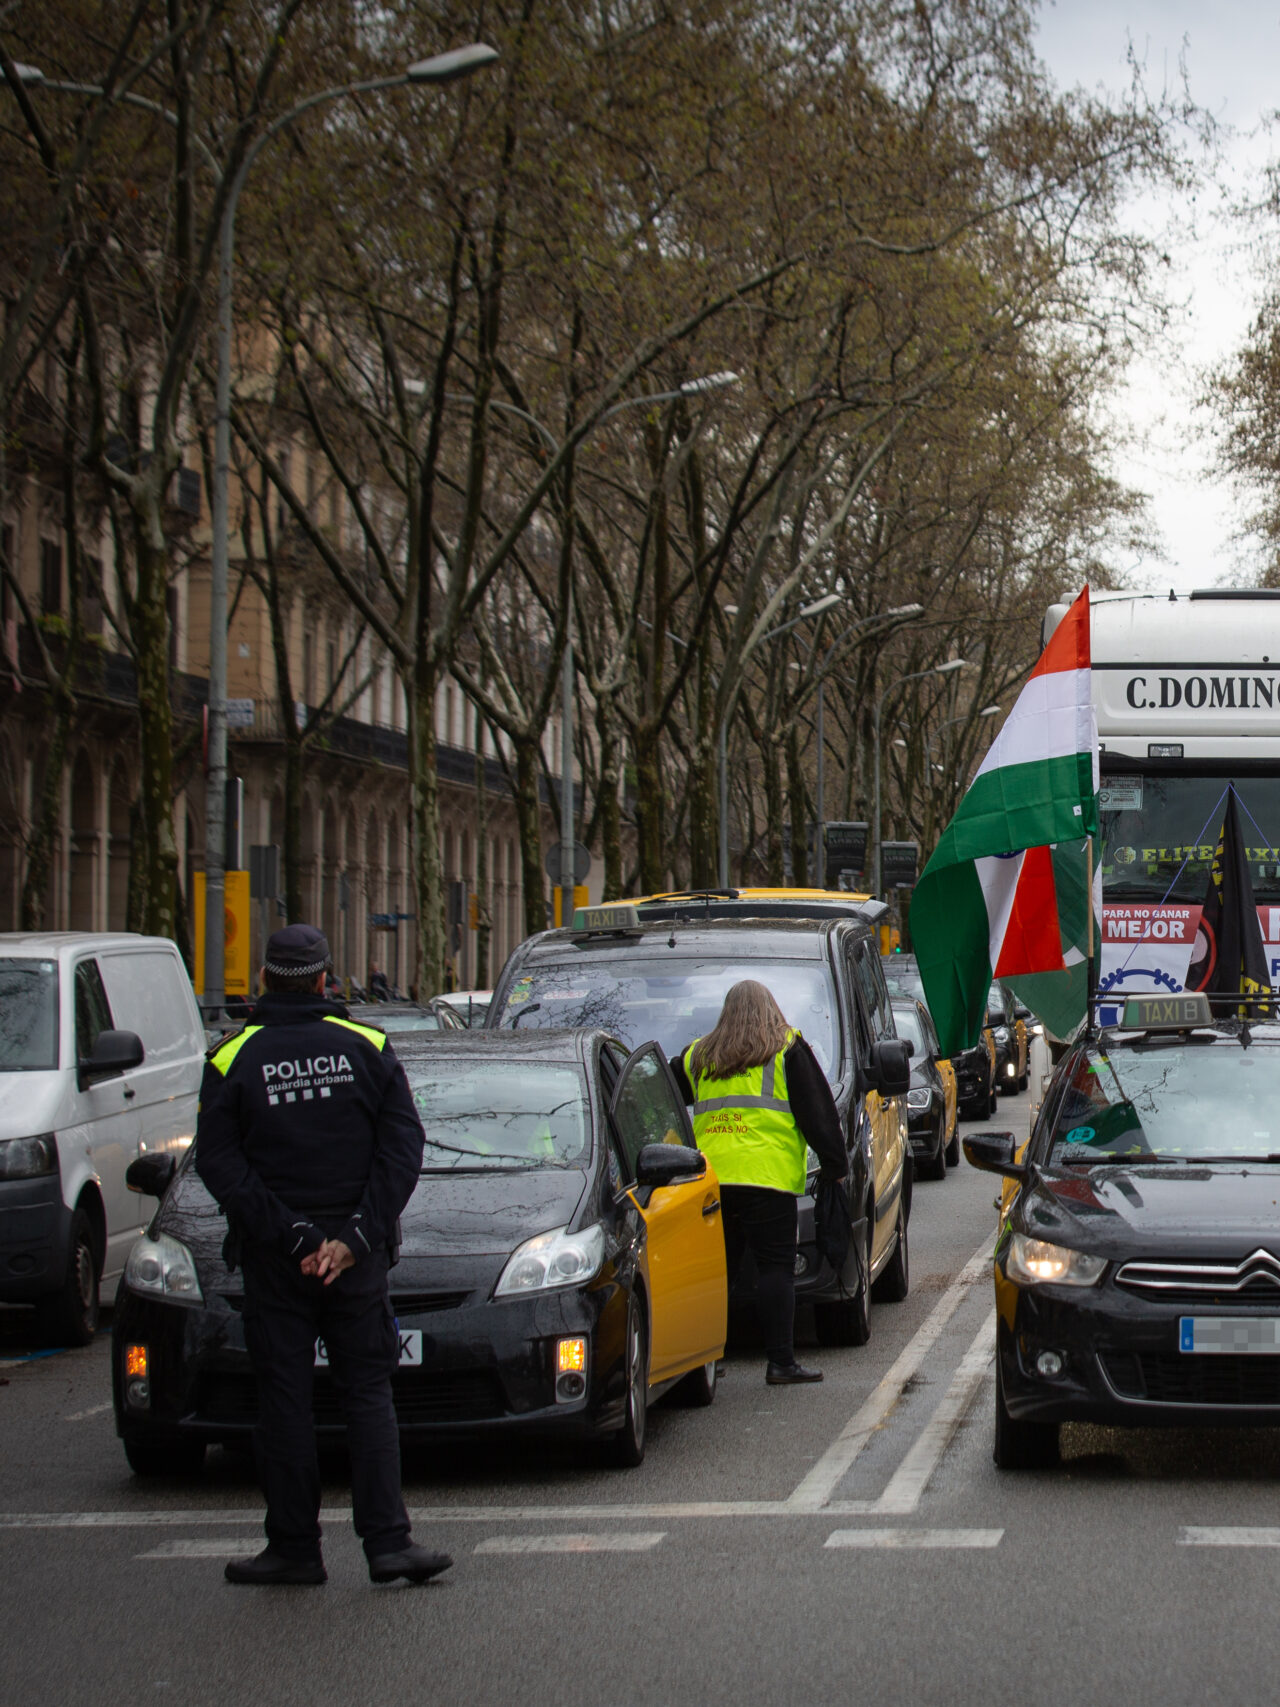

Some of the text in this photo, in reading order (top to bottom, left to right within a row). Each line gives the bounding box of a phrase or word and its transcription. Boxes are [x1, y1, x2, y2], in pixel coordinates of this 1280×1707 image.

[1141, 845, 1213, 862] ELITE
[587, 911, 615, 927] TAXI
[1102, 909, 1190, 919] PARA NO GANAR
[1107, 920, 1185, 939] MEJOR
[1143, 1001, 1180, 1023] TAXI
[262, 1054, 353, 1082] POLICIA
[313, 1073, 355, 1086] urbana
[736, 1125, 748, 1134] NO
